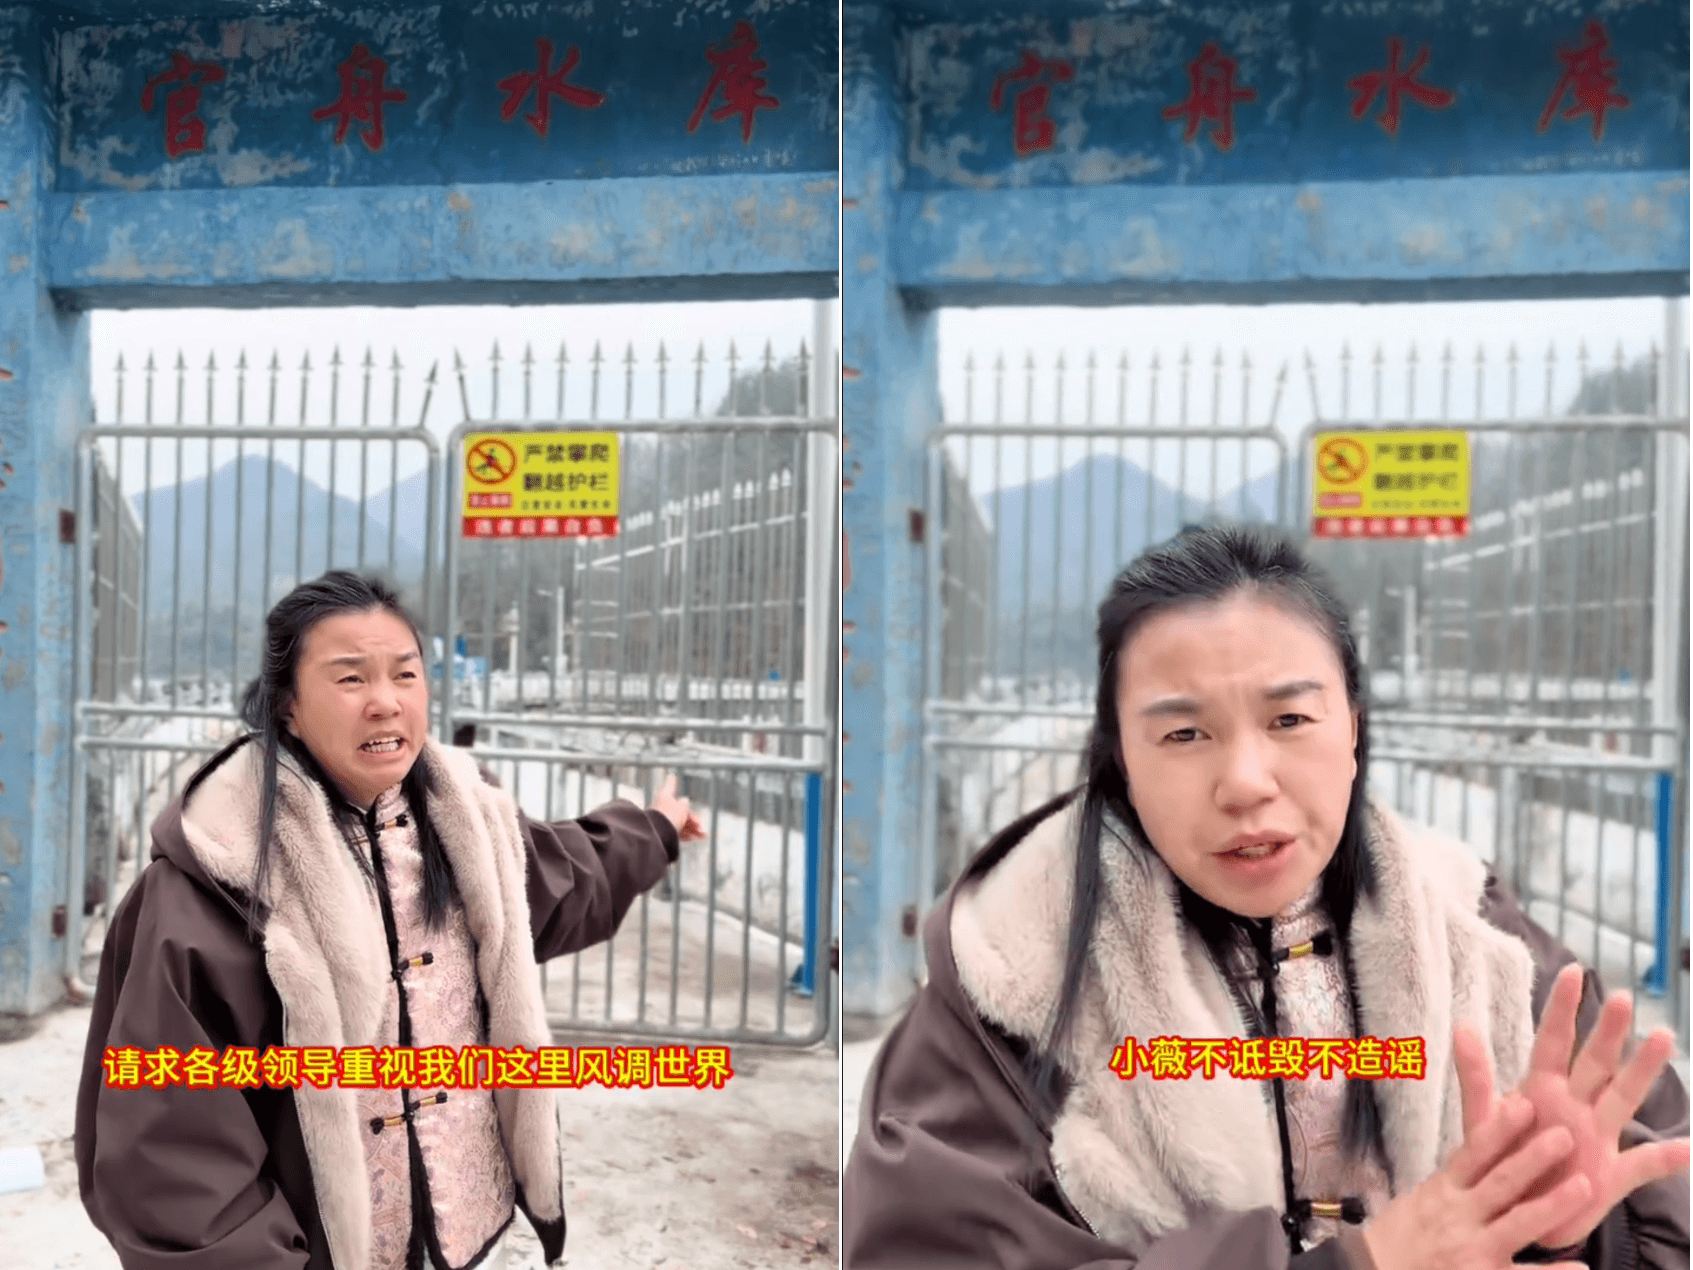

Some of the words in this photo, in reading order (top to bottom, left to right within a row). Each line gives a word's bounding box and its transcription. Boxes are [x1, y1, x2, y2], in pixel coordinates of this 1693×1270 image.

[143, 24, 778, 157] 官舟水库
[992, 24, 1628, 154] 官舟水库
